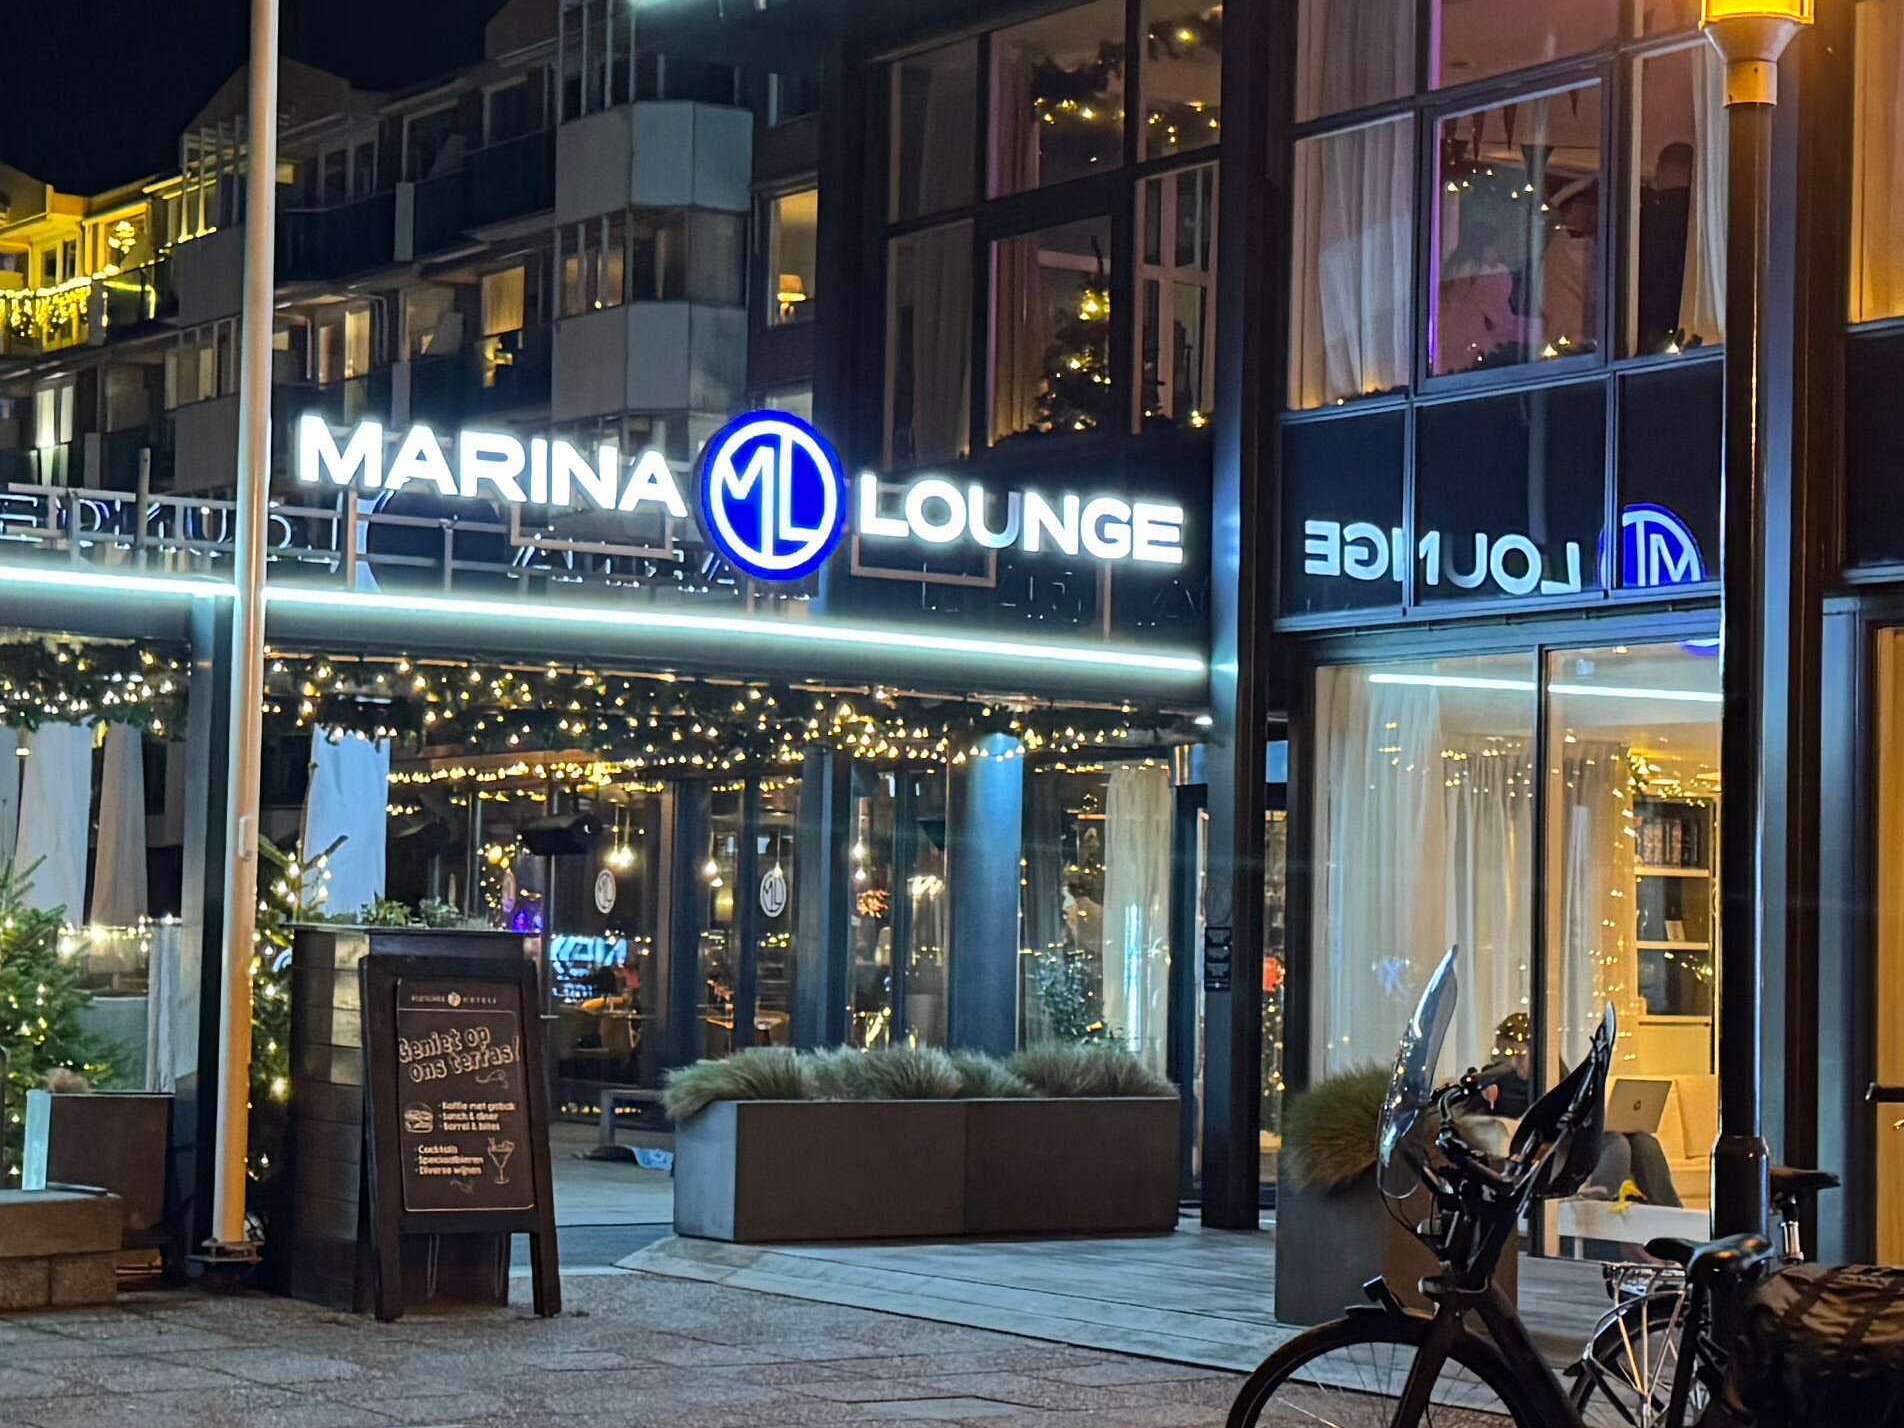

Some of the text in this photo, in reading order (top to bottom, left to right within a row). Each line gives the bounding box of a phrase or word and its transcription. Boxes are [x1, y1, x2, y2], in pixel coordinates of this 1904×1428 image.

[300, 414, 689, 518] MARINA
[860, 473, 1184, 564] LOUNGE
[398, 1026, 490, 1063] Geniet op
[409, 1059, 447, 1082] ons
